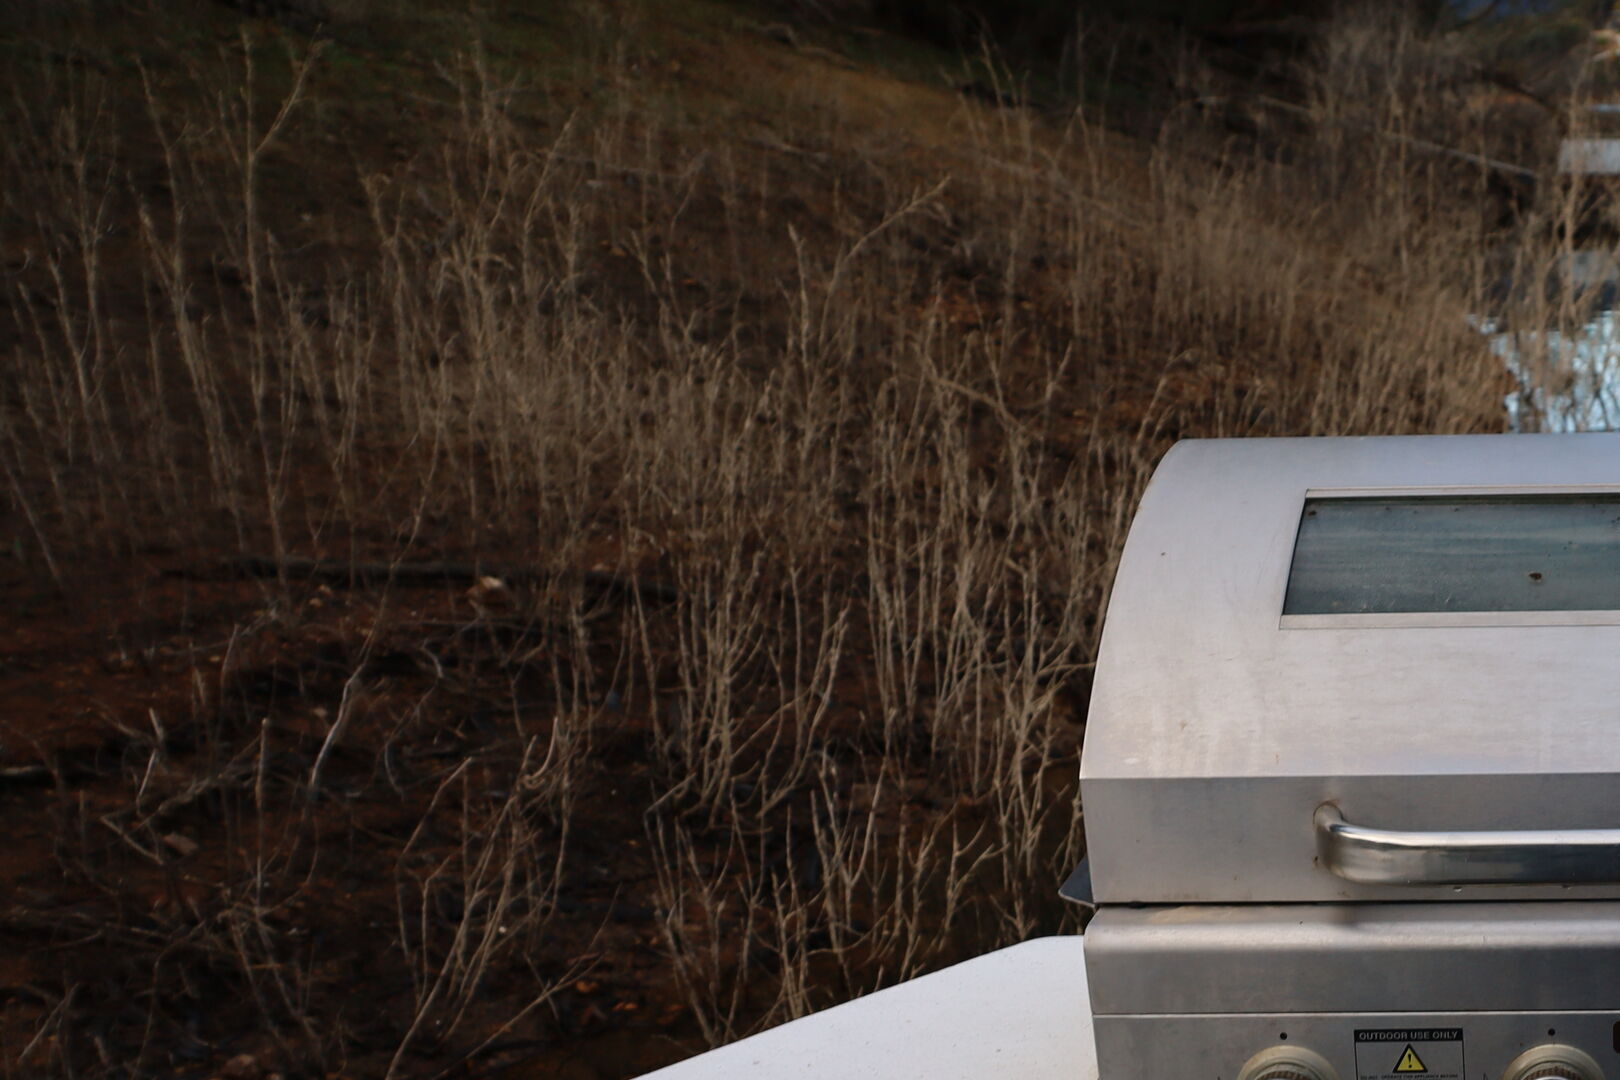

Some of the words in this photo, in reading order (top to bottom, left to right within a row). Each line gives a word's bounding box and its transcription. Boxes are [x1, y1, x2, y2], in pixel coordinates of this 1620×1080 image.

[1359, 1031, 1408, 1040] OUTDOOR
[1410, 1031, 1429, 1040] USE
[1432, 1030, 1458, 1039] ONLY
